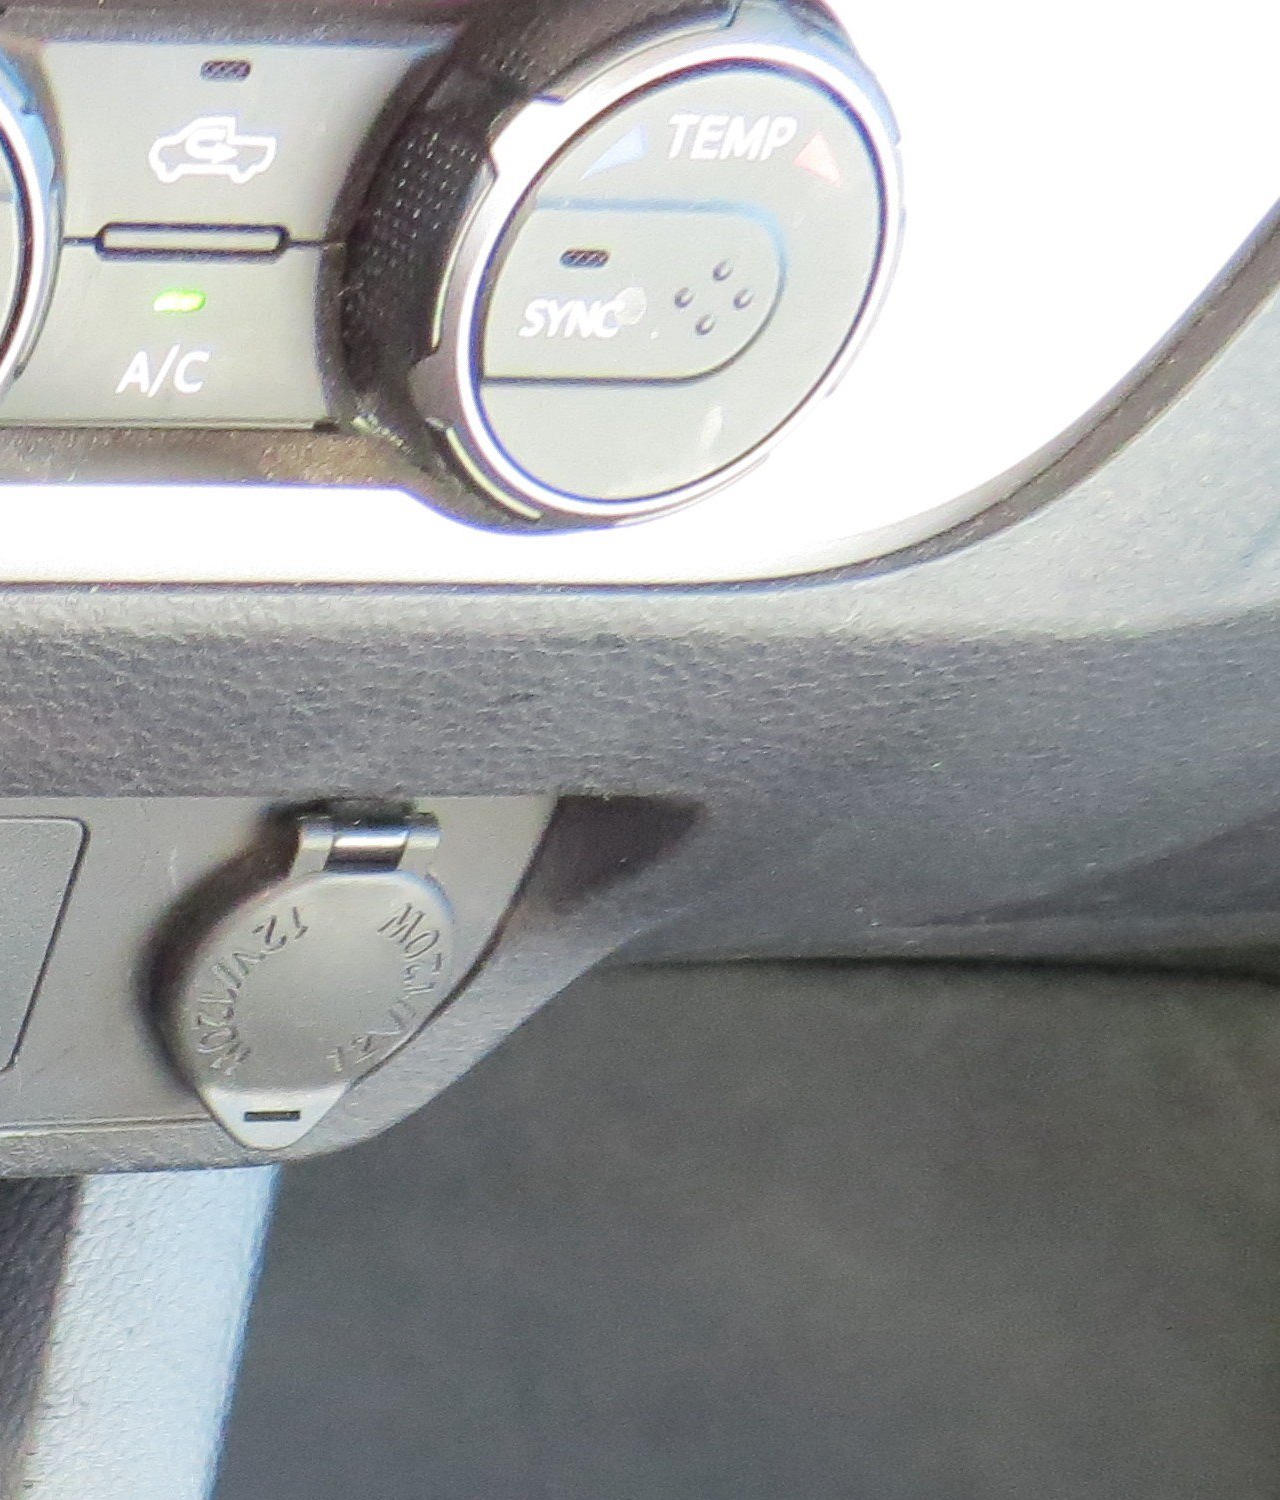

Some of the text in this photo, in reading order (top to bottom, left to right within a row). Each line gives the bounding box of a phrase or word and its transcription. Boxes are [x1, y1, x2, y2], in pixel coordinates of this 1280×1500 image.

[666, 112, 797, 162] TEMP
[517, 300, 625, 338] SYNC
[116, 346, 210, 395] A/C
